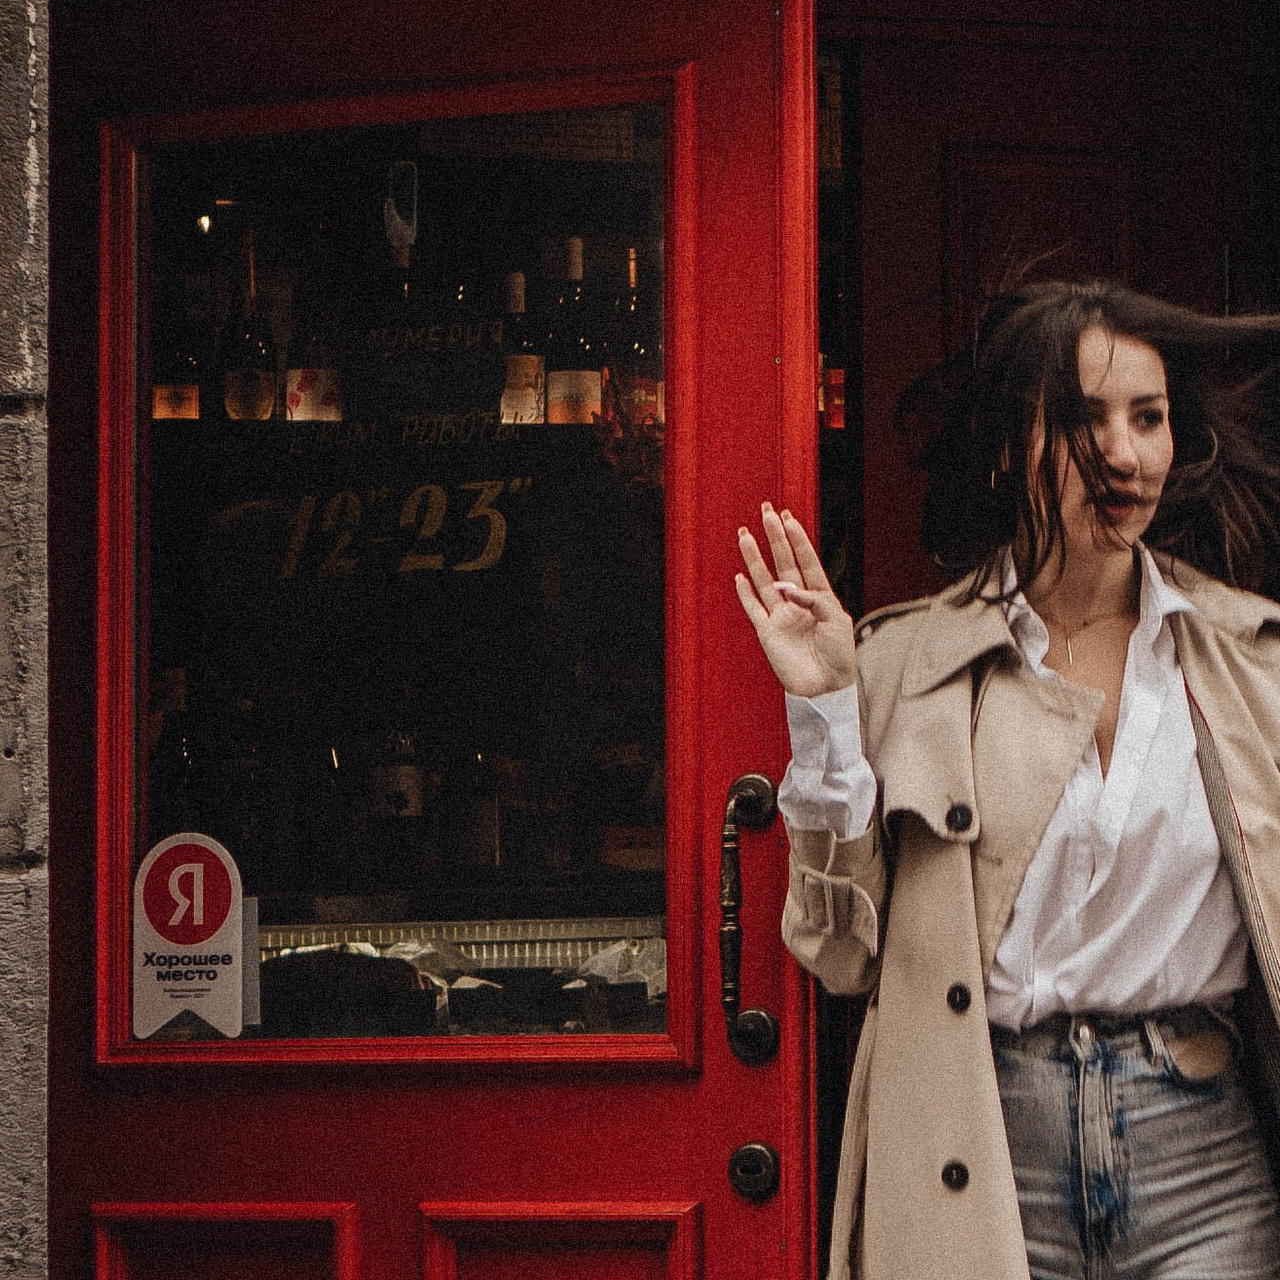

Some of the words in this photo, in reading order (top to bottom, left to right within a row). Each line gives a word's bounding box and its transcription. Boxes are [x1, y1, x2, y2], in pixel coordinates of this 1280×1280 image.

[168, 863, 204, 926] Я
[142, 951, 233, 969] Хорошее
[156, 969, 218, 982] место
